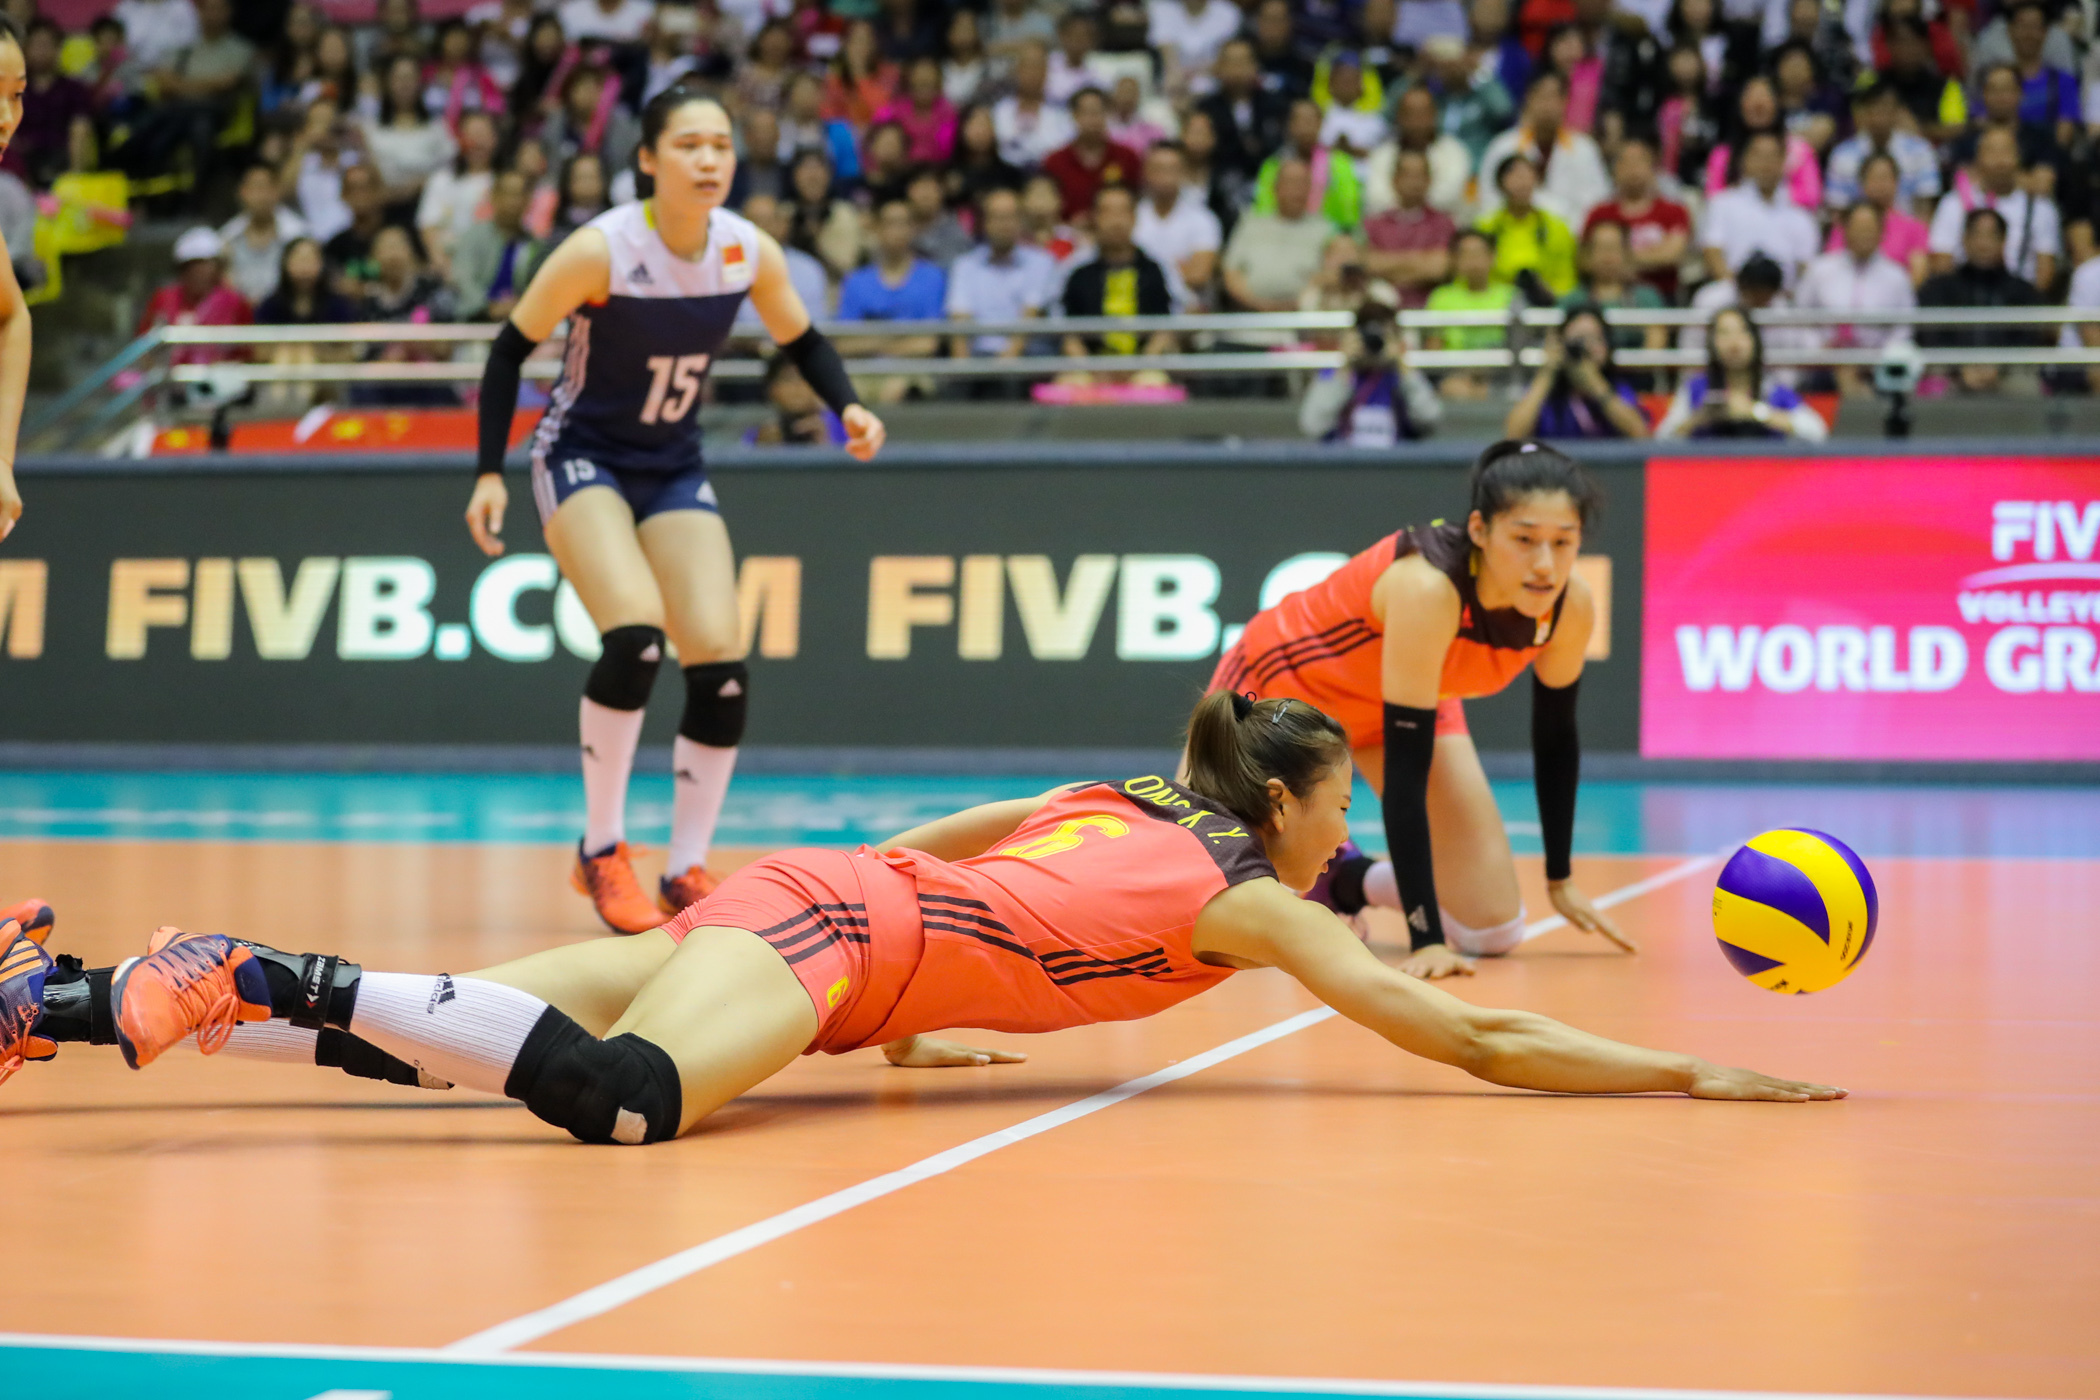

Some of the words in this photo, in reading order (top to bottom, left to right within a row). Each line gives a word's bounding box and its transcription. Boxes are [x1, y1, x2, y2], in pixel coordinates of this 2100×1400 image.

[640, 353, 710, 425] 15
[563, 457, 598, 485] 15
[1675, 624, 1969, 693] WORLD
[1984, 625, 2100, 693] GR
[998, 814, 1130, 860] 6
[826, 975, 849, 1009] 6
